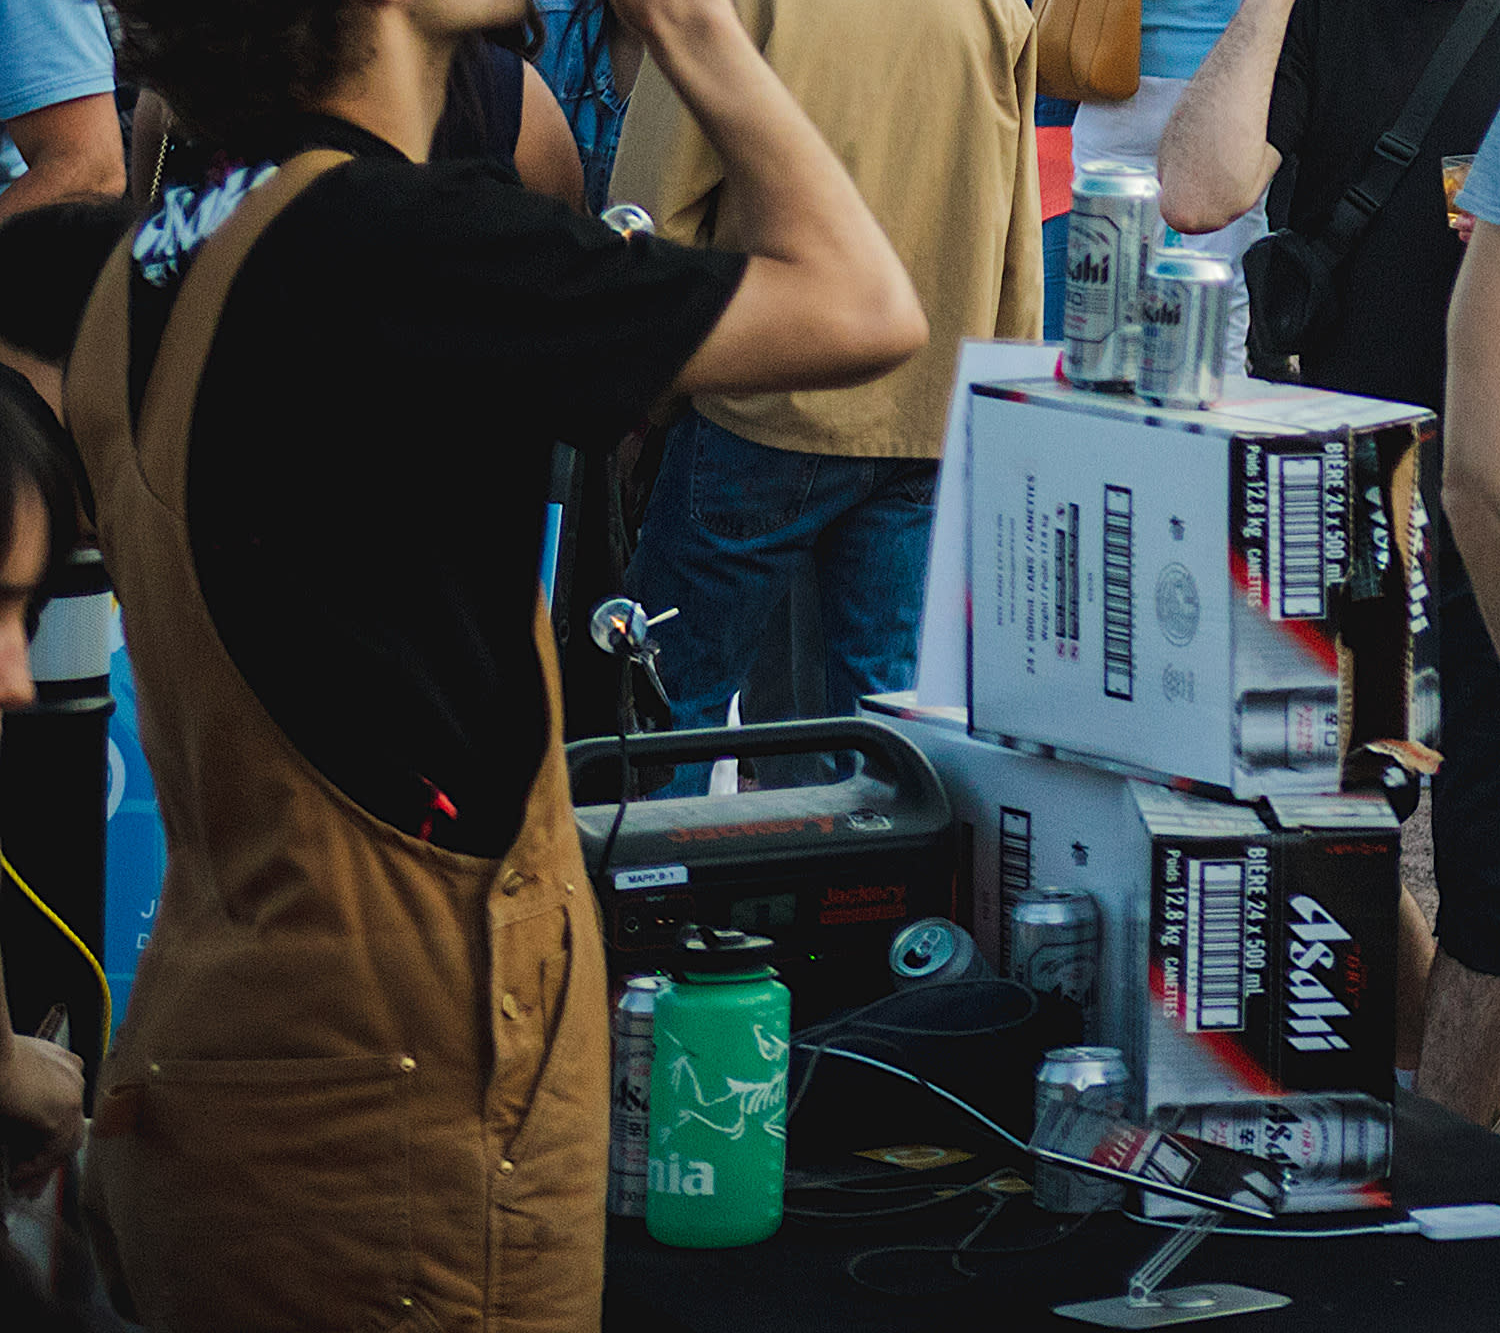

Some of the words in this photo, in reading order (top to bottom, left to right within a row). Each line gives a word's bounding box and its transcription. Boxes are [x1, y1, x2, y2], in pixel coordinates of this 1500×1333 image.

[1246, 444, 1262, 477] Poids
[1325, 443, 1348, 489] BIÈRE
[1246, 481, 1266, 514] 12.8
[1325, 493, 1345, 512] 24
[1242, 518, 1265, 539] kg
[1325, 530, 1346, 560] 500
[1165, 848, 1183, 883] Poids
[1247, 846, 1271, 896] BIÈRE
[1165, 887, 1186, 921] 12.8
[1247, 900, 1267, 921] 24
[1160, 925, 1185, 947] kg
[1246, 939, 1267, 970] 500
[1163, 956, 1180, 1020] CANETTES
[1286, 894, 1352, 1052] Asahi
